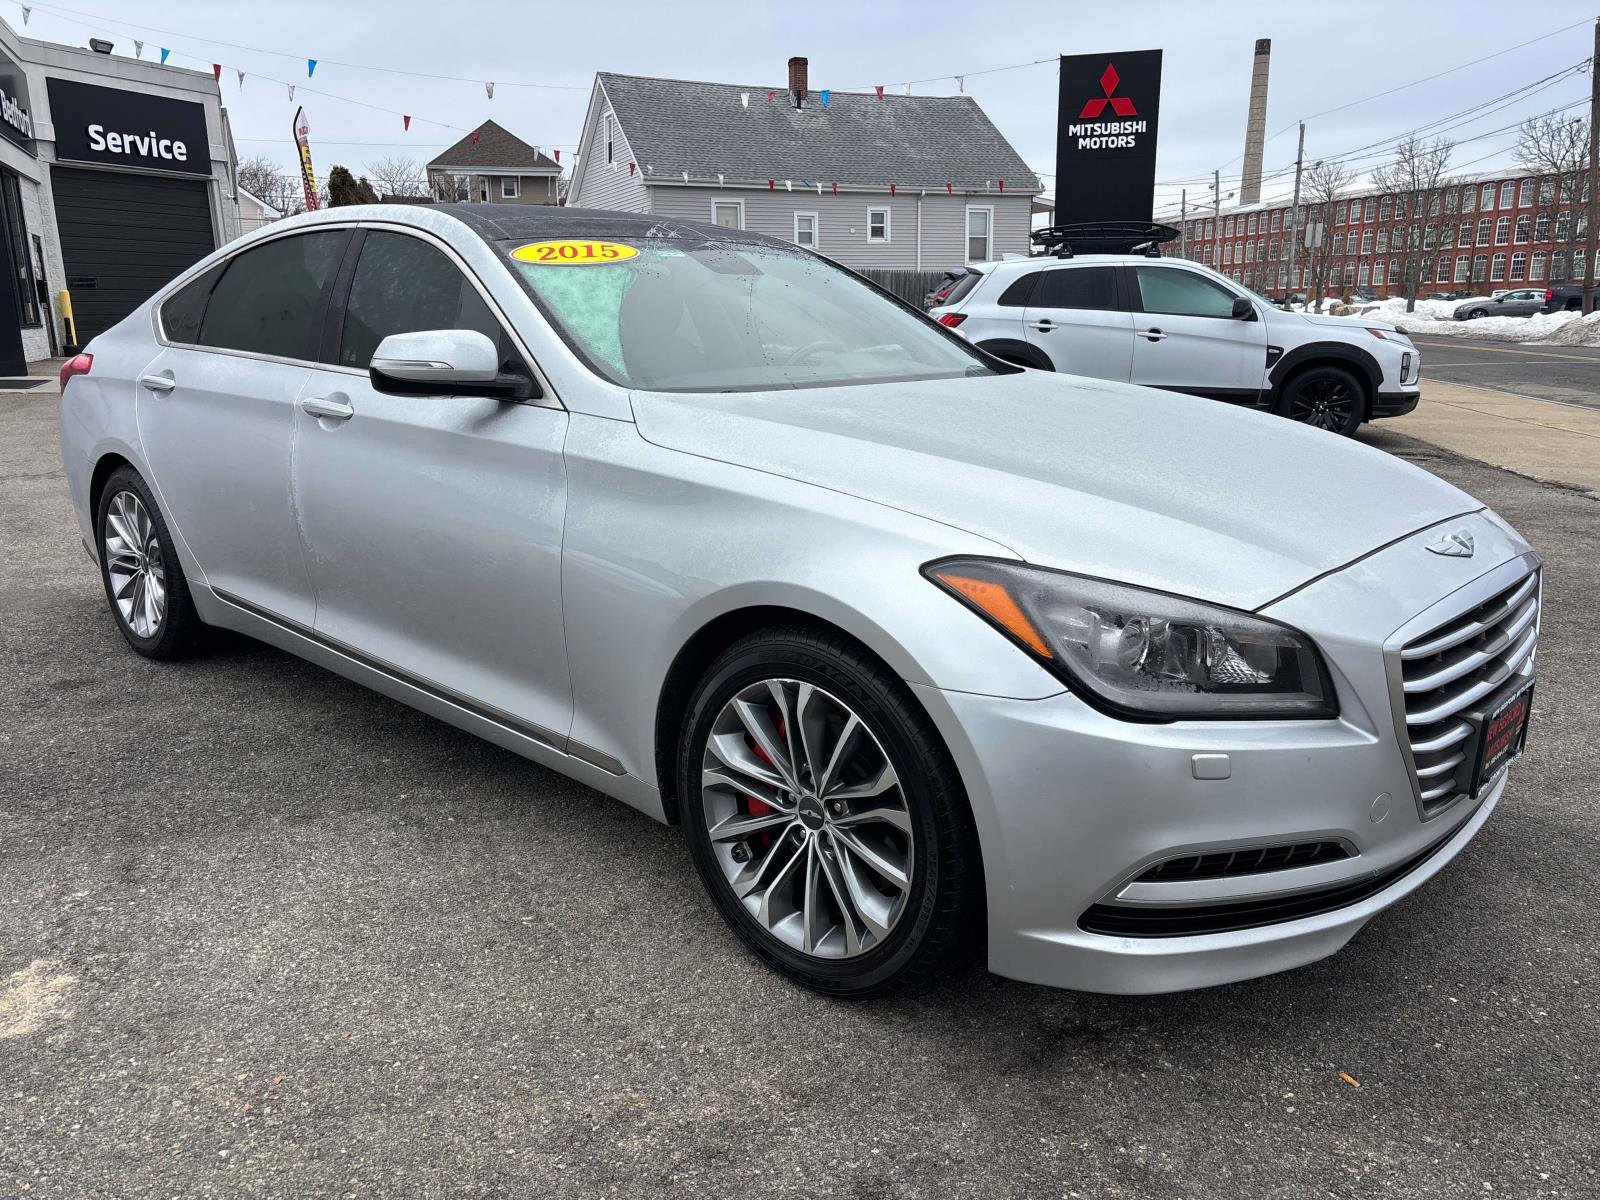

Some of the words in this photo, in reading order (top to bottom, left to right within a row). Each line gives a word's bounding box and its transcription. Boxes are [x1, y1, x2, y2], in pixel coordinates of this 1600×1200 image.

[1068, 120, 1147, 137] MITSUBISHI
[88, 124, 187, 161] Service
[1078, 135, 1136, 150] MOTORS
[536, 244, 620, 261] 2015
